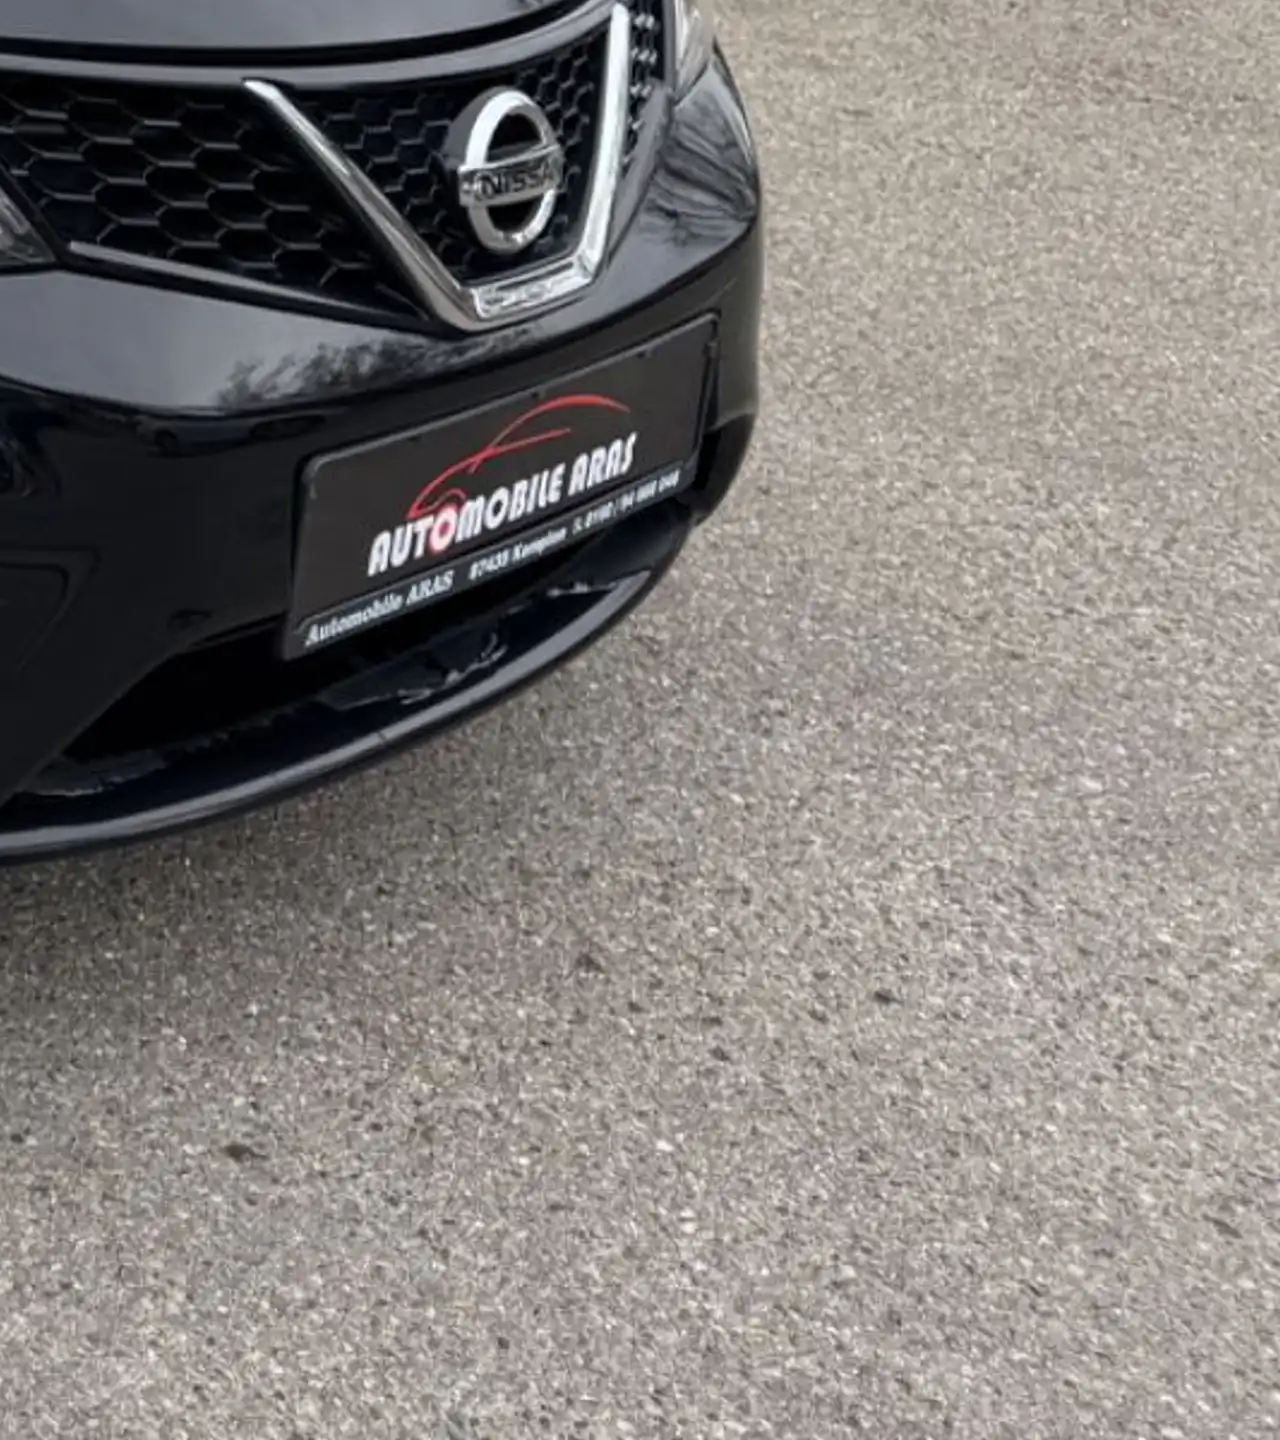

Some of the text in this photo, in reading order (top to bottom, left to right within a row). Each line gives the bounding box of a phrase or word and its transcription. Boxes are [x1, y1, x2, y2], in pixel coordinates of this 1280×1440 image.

[473, 159, 560, 200] NISSA
[368, 463, 566, 576] AUTOMOBILE
[568, 432, 637, 496] ARAS
[305, 592, 404, 647] Automobile
[406, 569, 455, 607] ARAS
